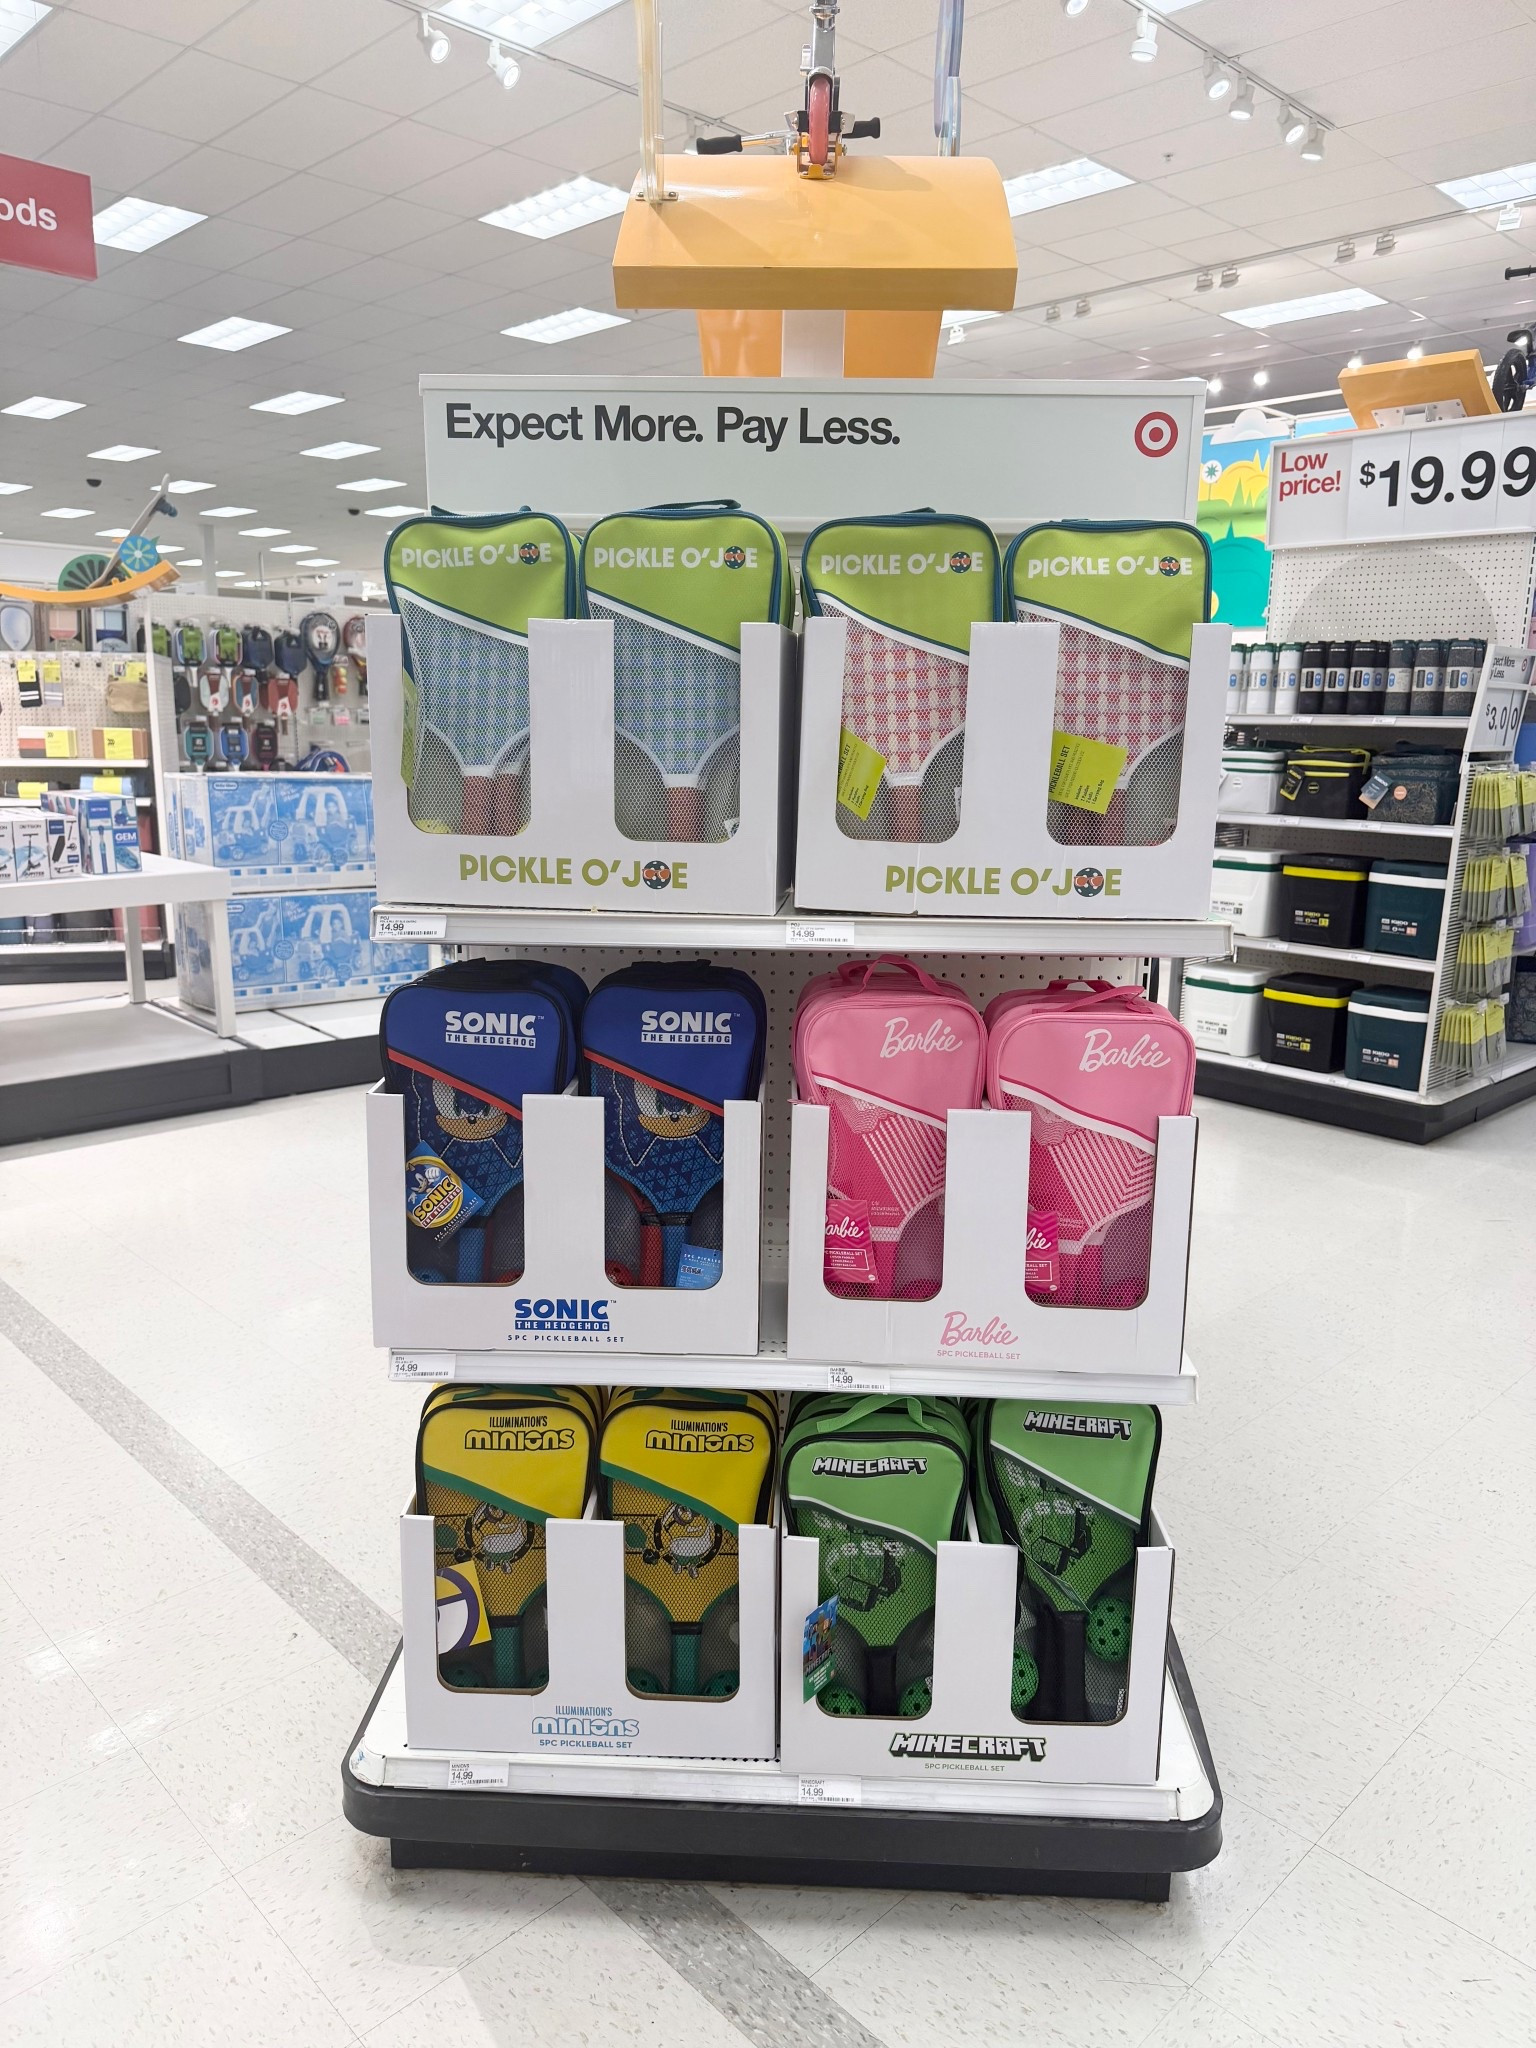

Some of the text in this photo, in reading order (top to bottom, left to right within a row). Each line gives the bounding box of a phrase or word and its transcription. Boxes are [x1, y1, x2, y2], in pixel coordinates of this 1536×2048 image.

[446, 402, 901, 452] Expect More. Pay Less.
[1281, 452, 1329, 473] Low
[1279, 470, 1341, 502] price!
[1359, 446, 1536, 507] $19.99
[400, 547, 474, 568] PICKLE
[594, 547, 674, 568] PICKLE
[821, 553, 901, 575] PICKLE
[1028, 557, 1110, 579] PICKLE
[1060, 745, 1071, 758] SET
[115, 832, 137, 841] GEM
[459, 853, 572, 885] PICKLE
[885, 864, 1001, 895] PICKLE
[380, 923, 405, 931] 14.99
[791, 930, 815, 938] 14.99
[445, 1010, 536, 1036] SONIC
[640, 1010, 732, 1033] SONIC
[446, 1033, 536, 1047] THE HEDGEHOG
[642, 1033, 731, 1044] THE HEDGEHOG
[879, 1016, 964, 1059] Barbie
[1078, 1028, 1171, 1073] Barbie
[414, 1178, 456, 1221] SONIC
[514, 1298, 609, 1320] SONIC
[516, 1320, 609, 1331] THE HEDGEHOG
[940, 1310, 1019, 1346] Barbie
[937, 1349, 1021, 1360] 5PC PICKLEBALL SET
[395, 1363, 418, 1372] 14.99
[831, 1375, 853, 1384] 14.99
[489, 1416, 548, 1428] ILLUMINATION'S
[670, 1419, 729, 1432] ILLUMINATION'S
[1023, 1410, 1133, 1441] MINECRAFT
[811, 1456, 928, 1479] MINECRAFT
[555, 1704, 613, 1717] ILLUMINATION'S
[539, 1739, 633, 1749] 5PC PICKLEBALL SET
[889, 1732, 1047, 1763] MINECRAFT
[451, 1771, 473, 1780] 14.99
[941, 1763, 989, 1771] PICKLEBALL
[801, 1787, 824, 1797] 14.99
